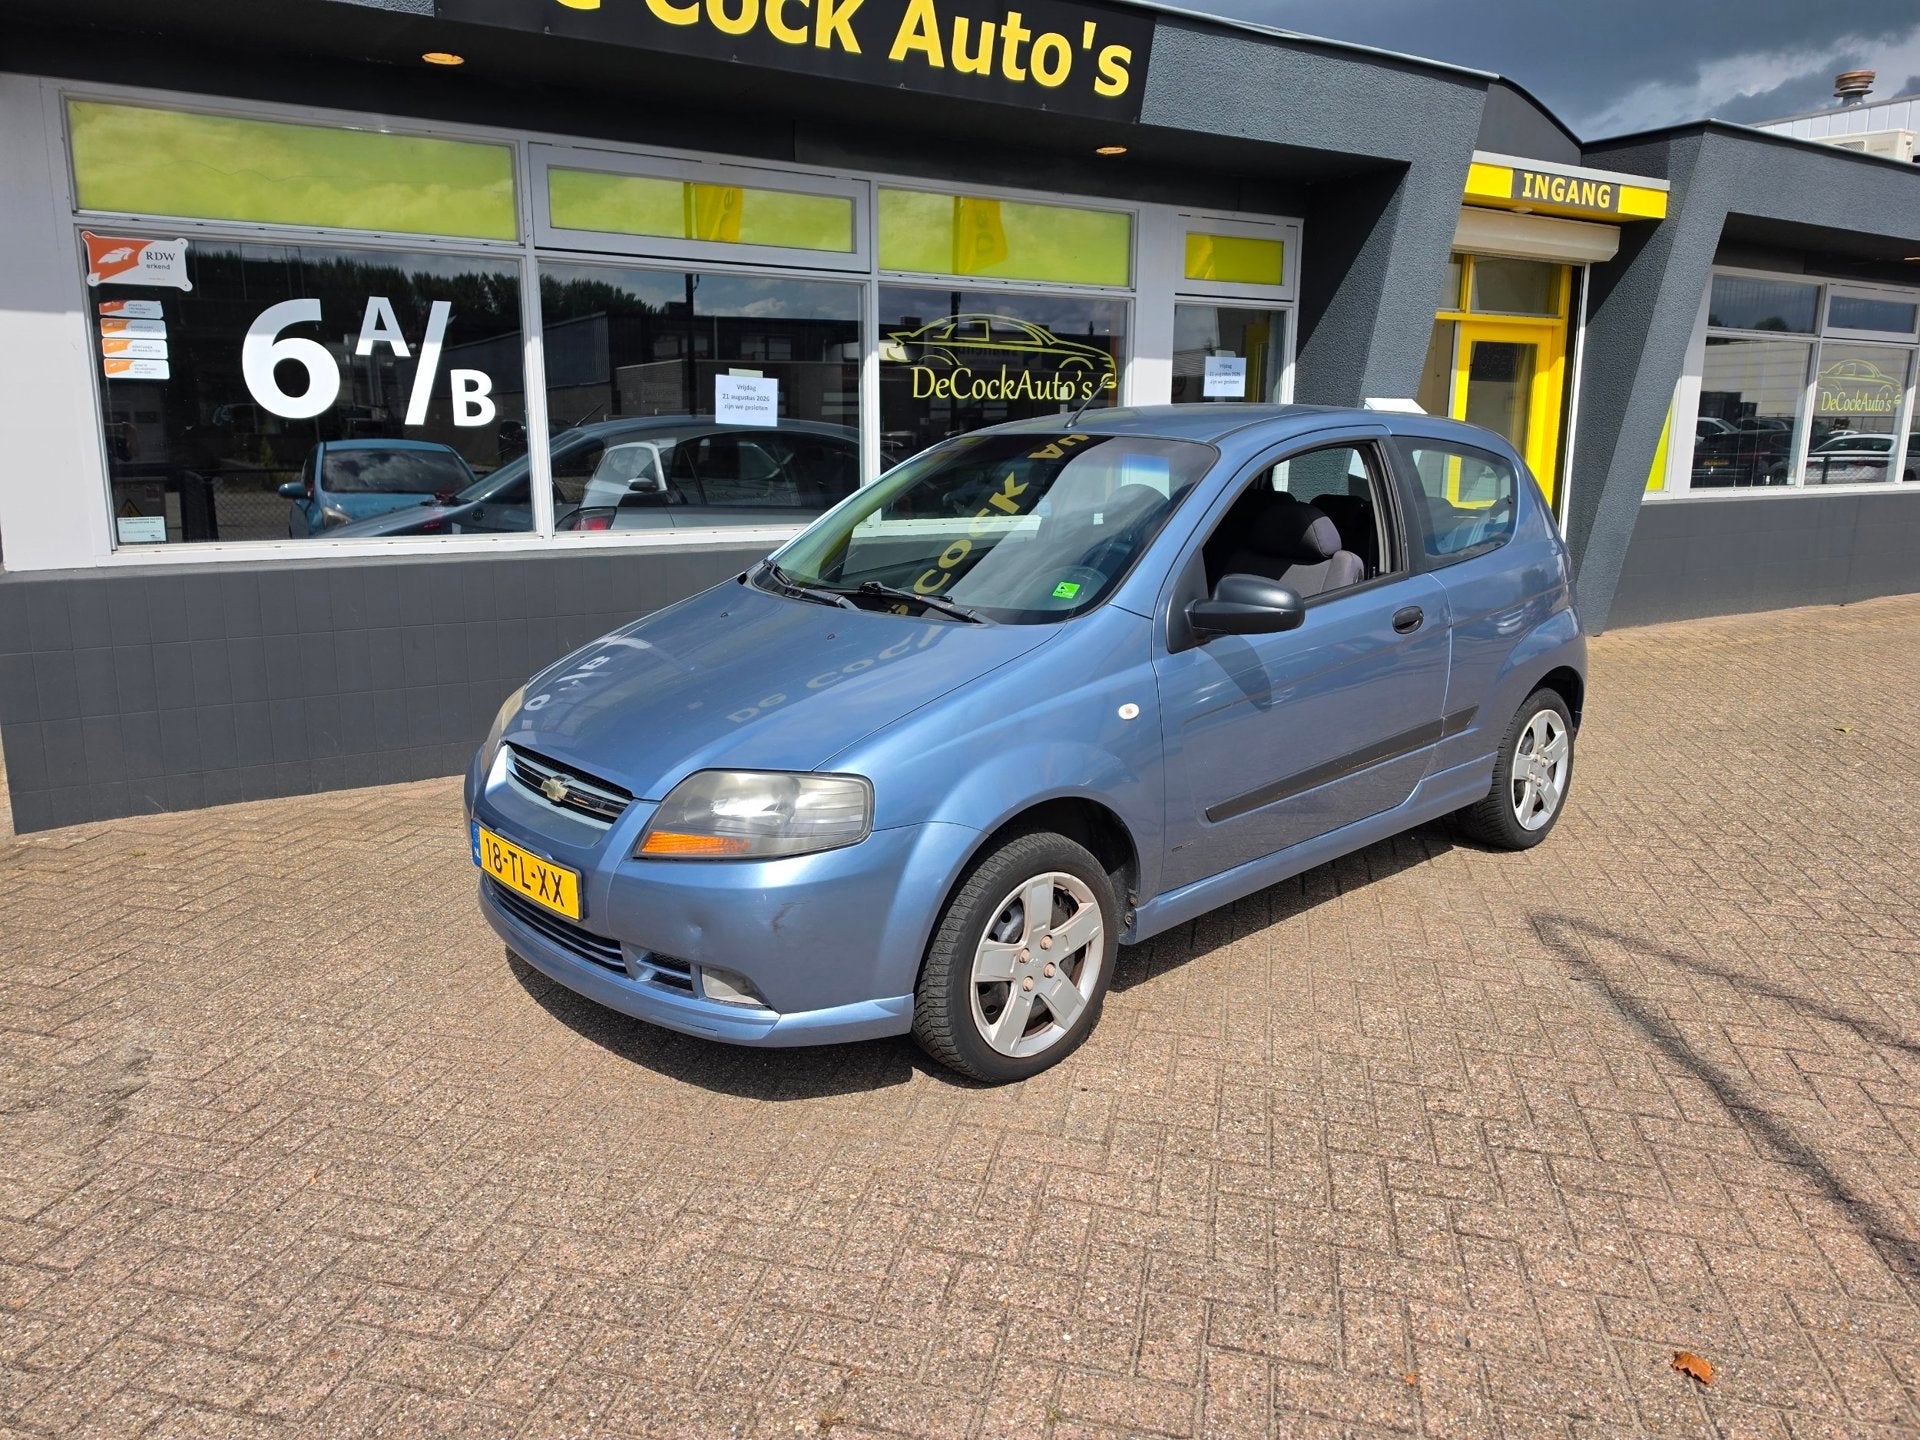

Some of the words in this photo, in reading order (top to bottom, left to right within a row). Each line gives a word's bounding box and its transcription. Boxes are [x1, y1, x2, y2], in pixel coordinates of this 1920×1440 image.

[889, 0, 1133, 98] Auto's
[1522, 172, 1611, 209] INGANG
[145, 251, 176, 262] RDW
[146, 263, 171, 271] erkend
[736, 384, 757, 392] Vrijdag
[910, 364, 1093, 400] DeCockAuto's
[1821, 388, 1892, 412] DeCockAuto's
[486, 837, 566, 908] 18-TL-XX
